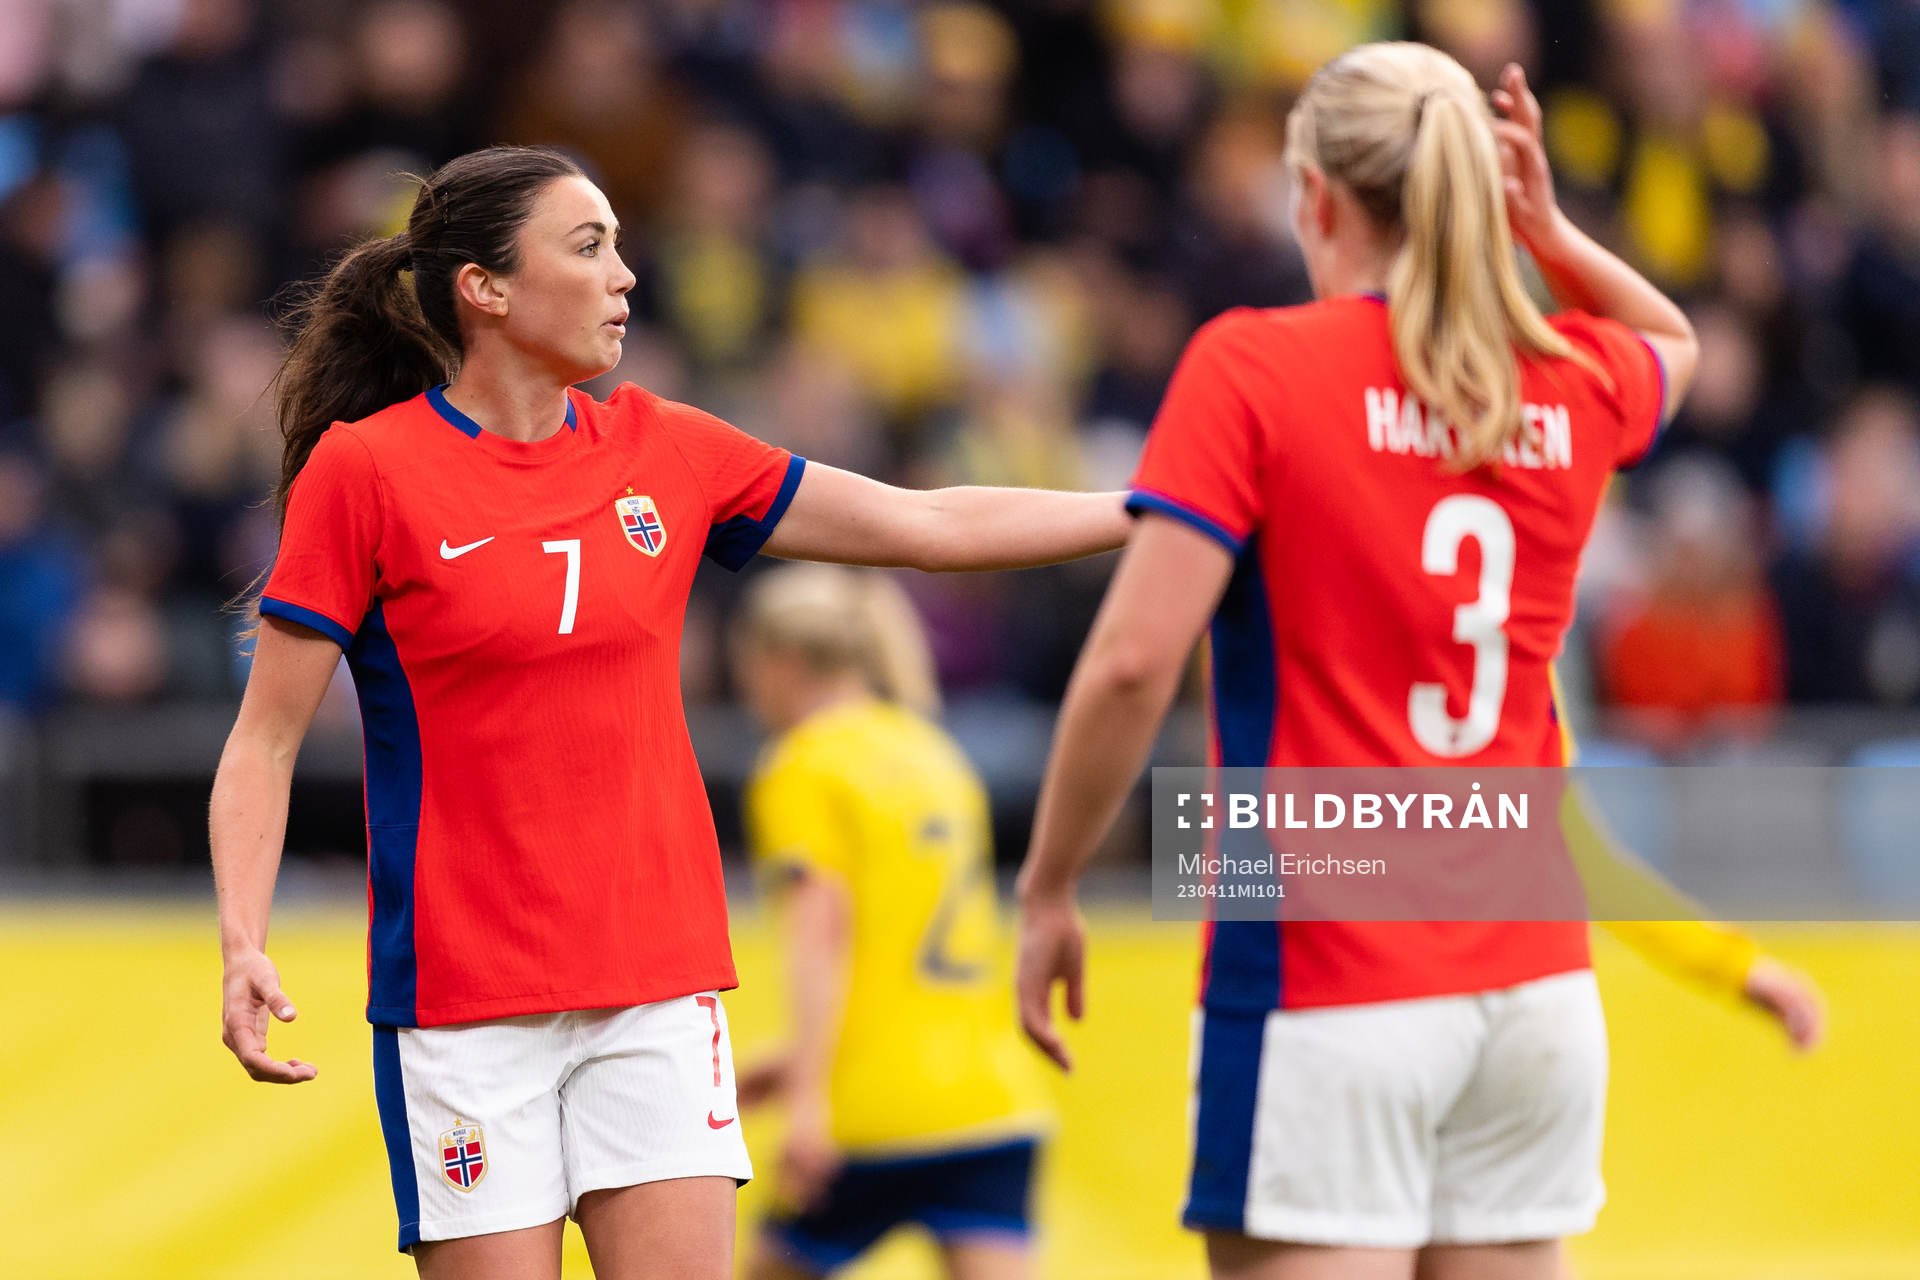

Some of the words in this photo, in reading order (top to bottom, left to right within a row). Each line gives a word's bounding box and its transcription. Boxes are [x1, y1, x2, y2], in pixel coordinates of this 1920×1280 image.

[541, 538, 581, 635] 7
[1407, 493, 1517, 760] 3
[695, 996, 721, 1087] 7
